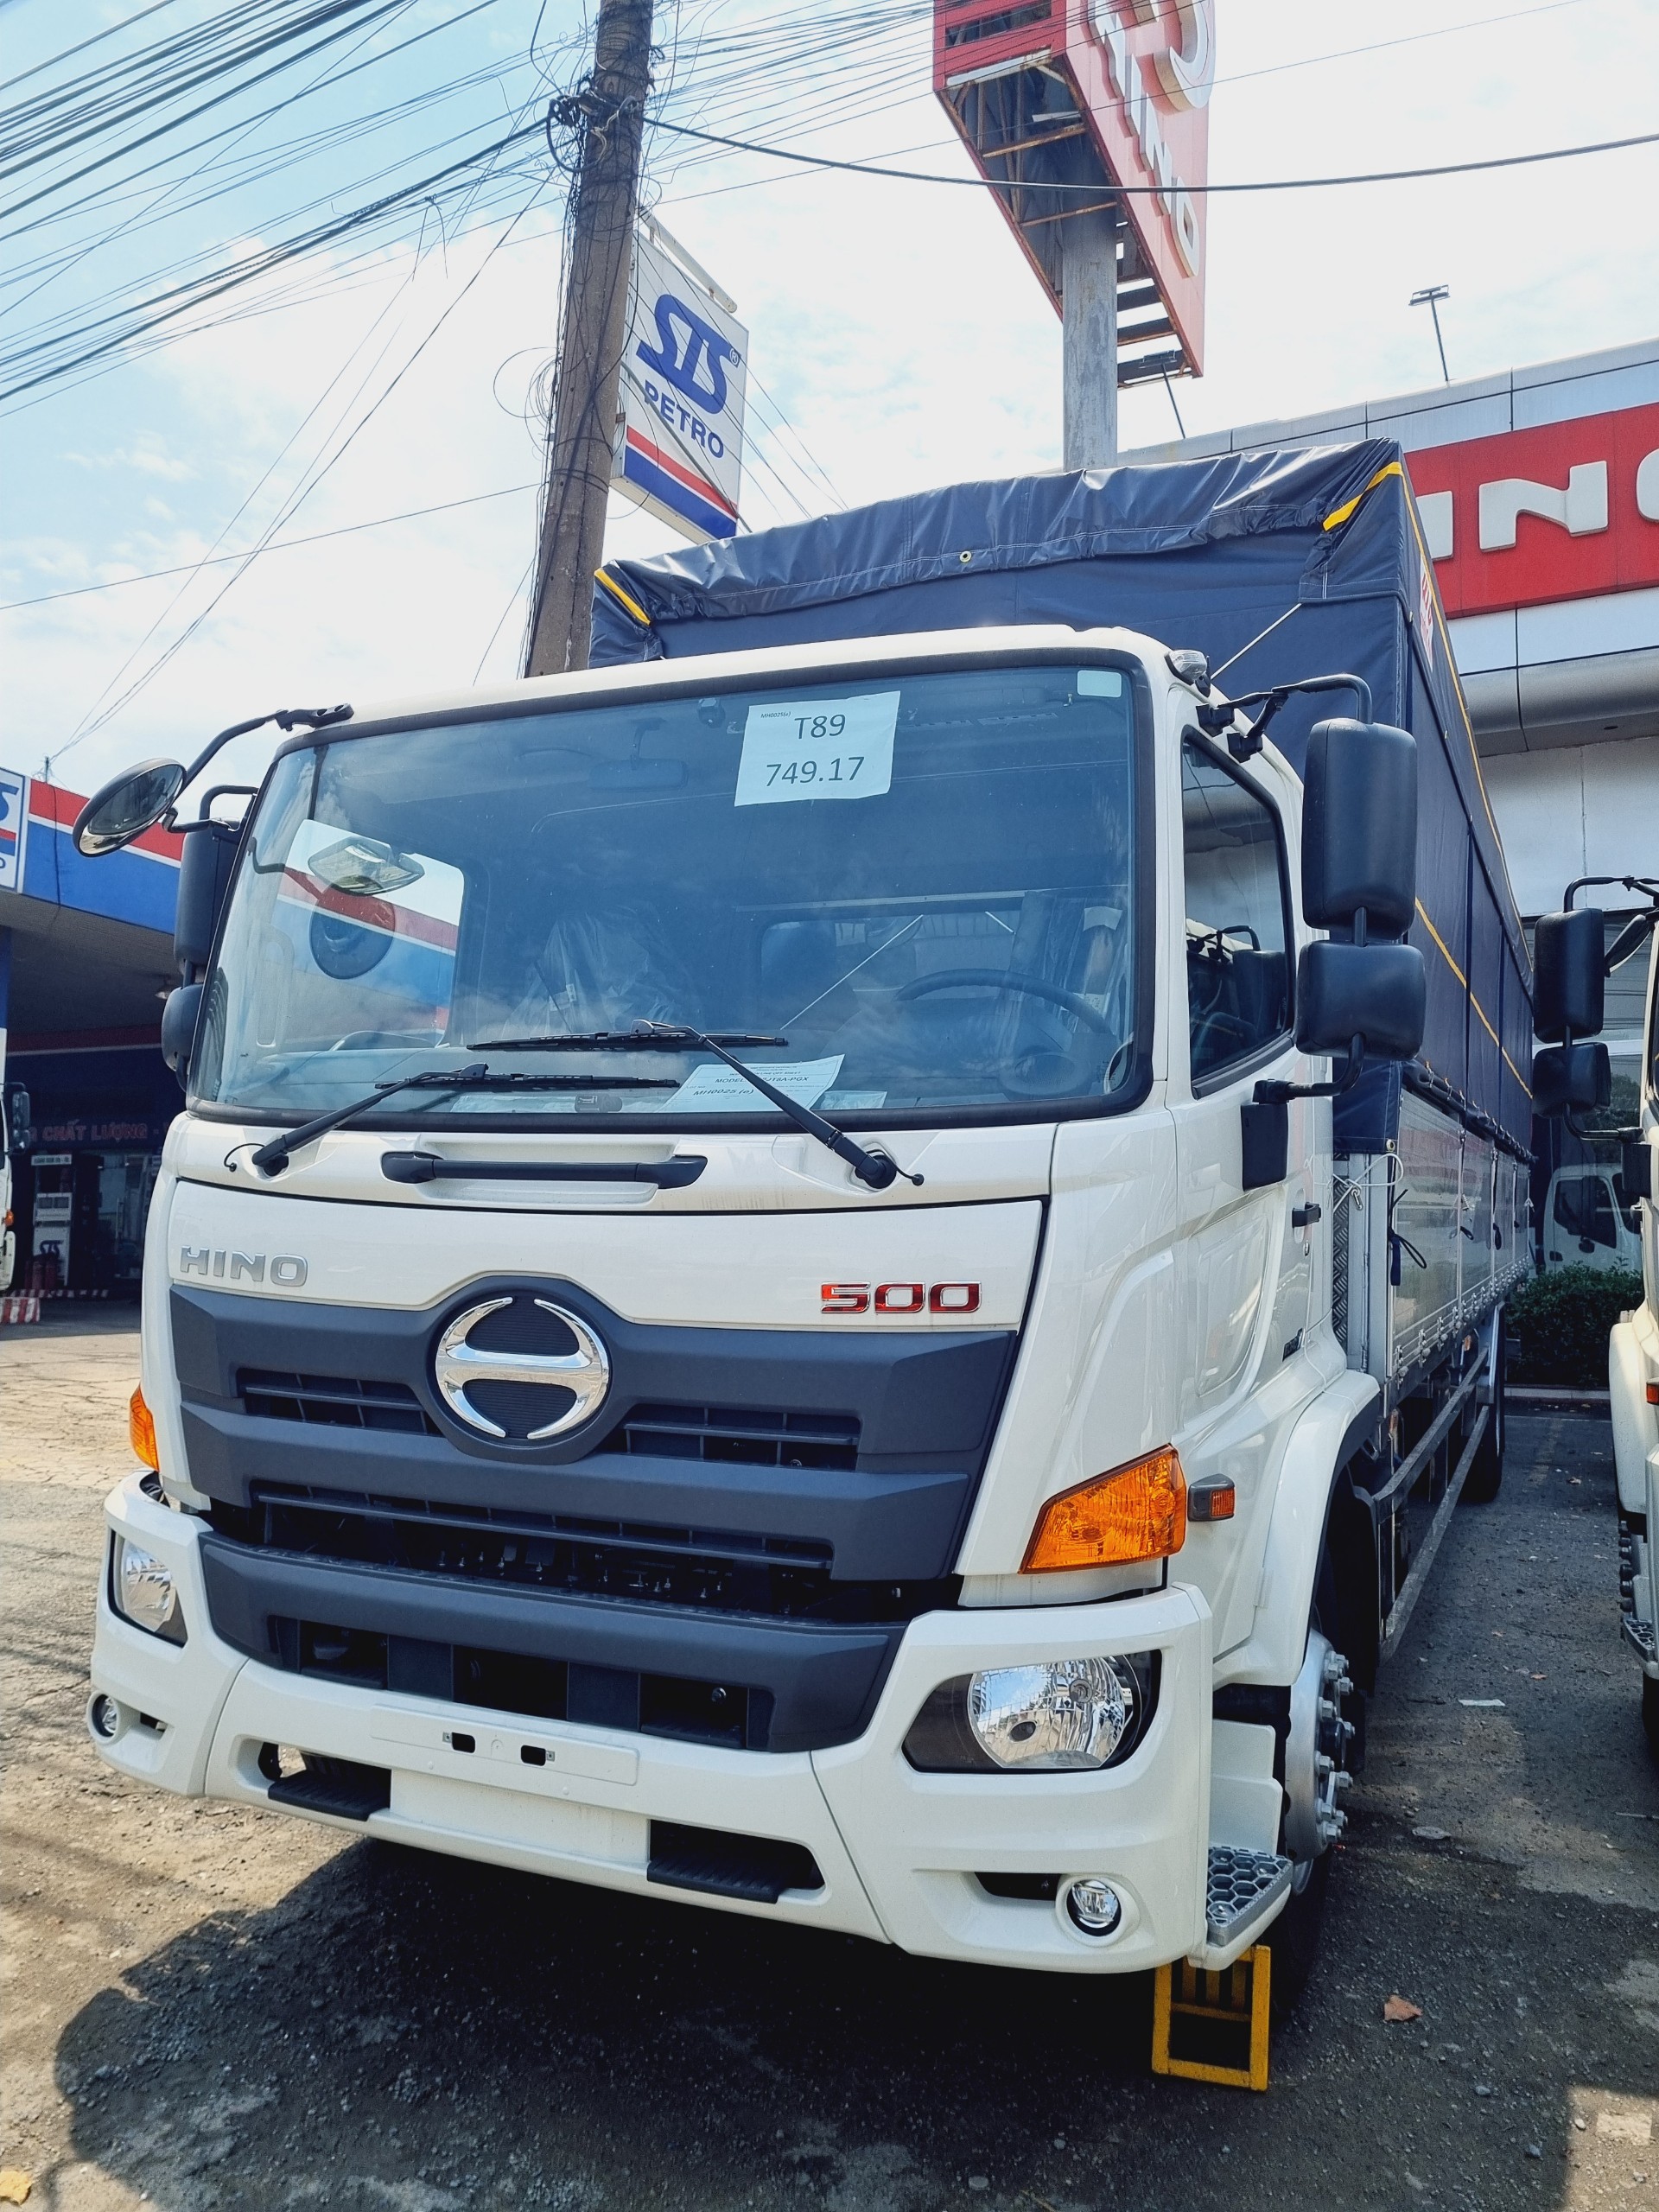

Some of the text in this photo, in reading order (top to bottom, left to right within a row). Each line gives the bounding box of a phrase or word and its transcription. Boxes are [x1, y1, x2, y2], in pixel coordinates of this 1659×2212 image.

[645, 379, 724, 459] PETRO
[794, 714, 846, 740] T89
[766, 756, 865, 787] 749.17
[180, 1245, 308, 1287] HINO
[821, 1281, 982, 1313] 500
